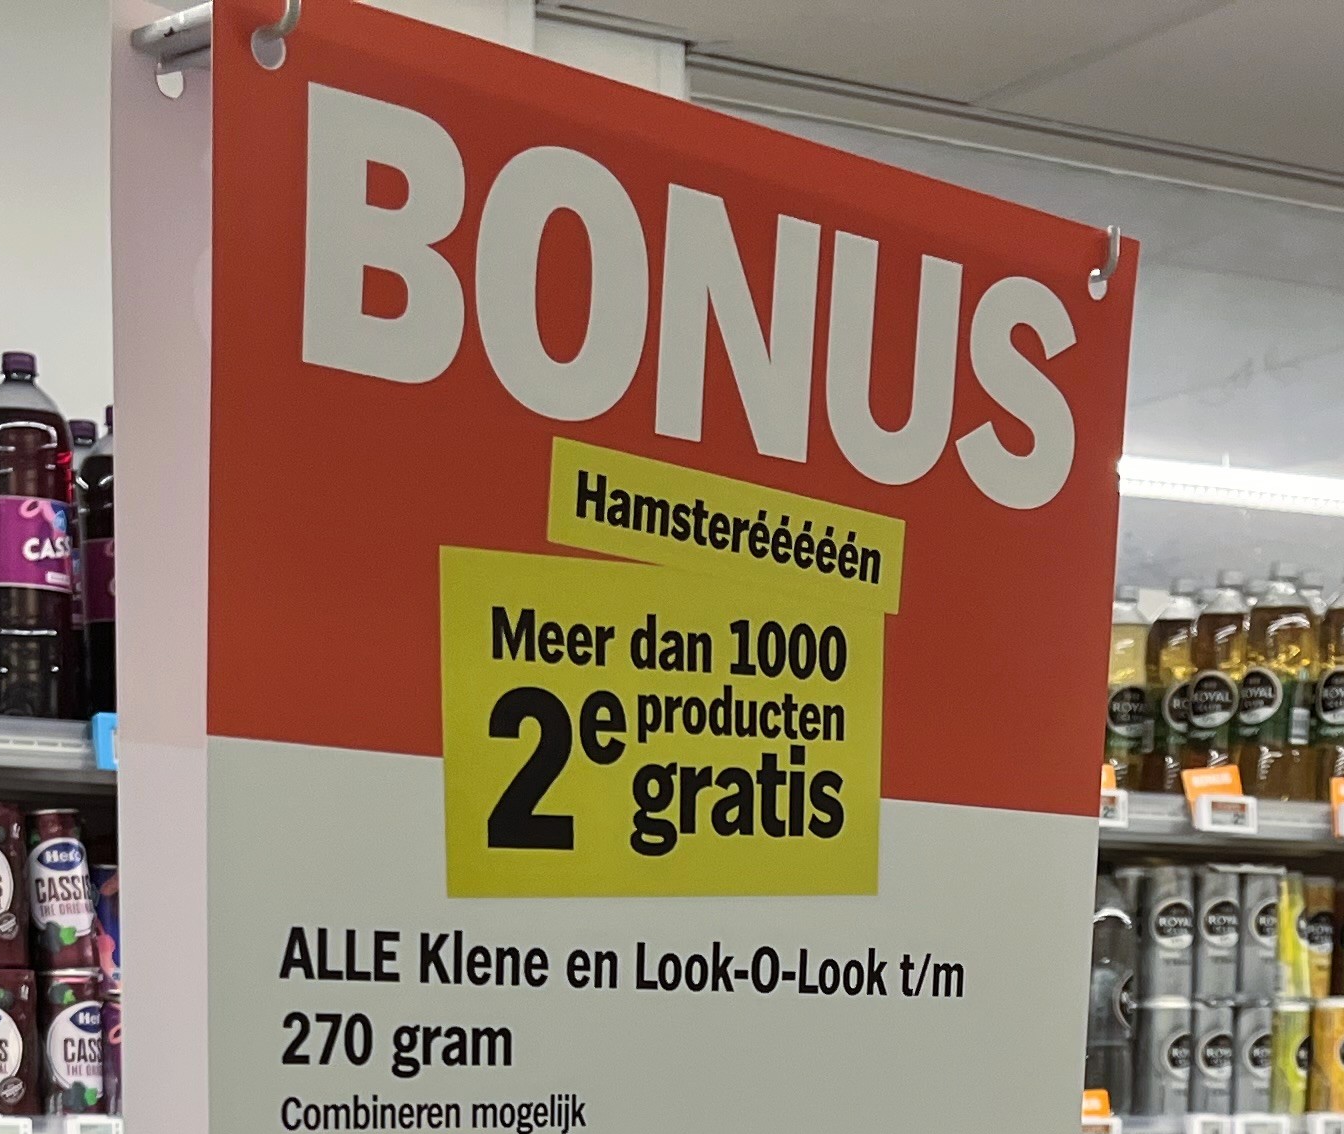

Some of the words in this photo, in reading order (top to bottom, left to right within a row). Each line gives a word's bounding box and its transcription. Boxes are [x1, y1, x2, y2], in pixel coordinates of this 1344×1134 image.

[302, 81, 1078, 510] BONUS
[576, 469, 882, 585] Hamsterééééén
[492, 605, 615, 667] Meer
[630, 613, 712, 673] dan
[729, 619, 848, 682] 1000
[637, 684, 846, 743] producten
[487, 686, 627, 851] 2e
[629, 745, 845, 857] gratis
[278, 925, 401, 983] ALLE
[419, 931, 550, 988] Klene
[566, 946, 618, 989] en
[635, 941, 887, 996] Look-O-Look
[899, 949, 965, 999] t/m
[281, 1012, 373, 1067] 270
[390, 1021, 513, 1078] gram
[280, 1094, 461, 1132] Combineren
